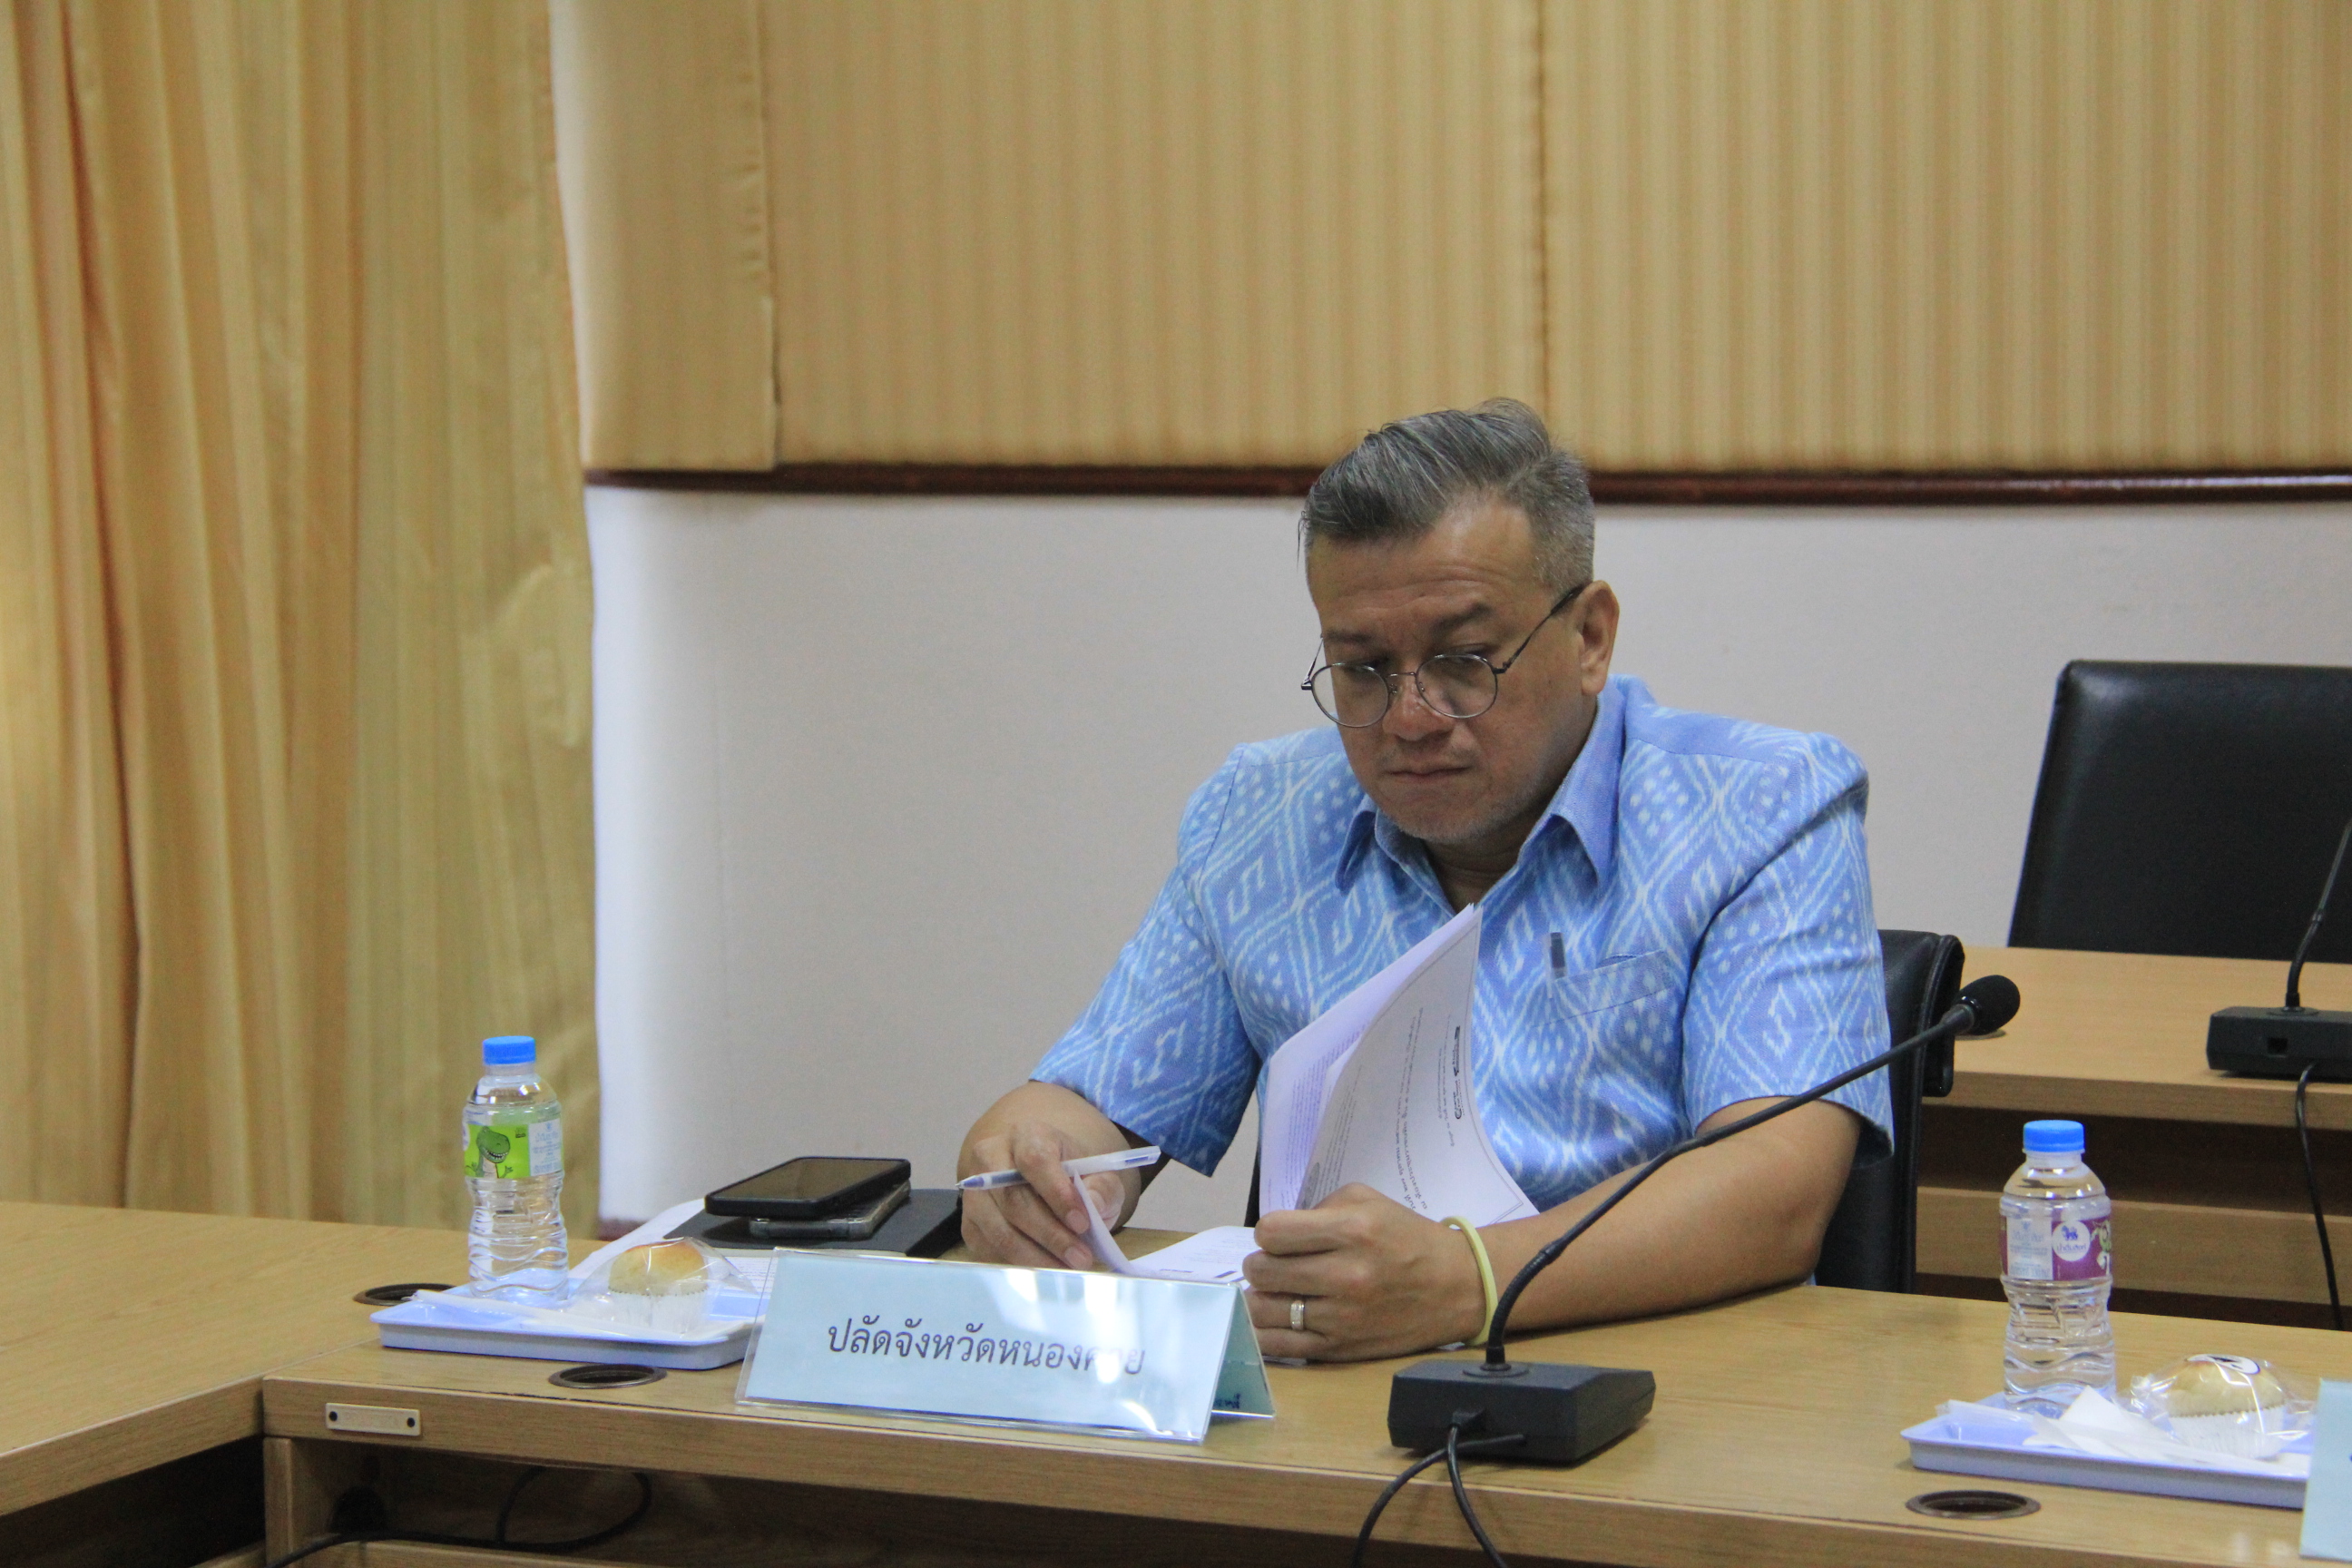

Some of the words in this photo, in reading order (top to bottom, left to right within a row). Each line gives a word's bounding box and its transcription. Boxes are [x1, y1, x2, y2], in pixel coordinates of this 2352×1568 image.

[827, 1315, 1145, 1375] ปลัดจังหวัดหนองย
